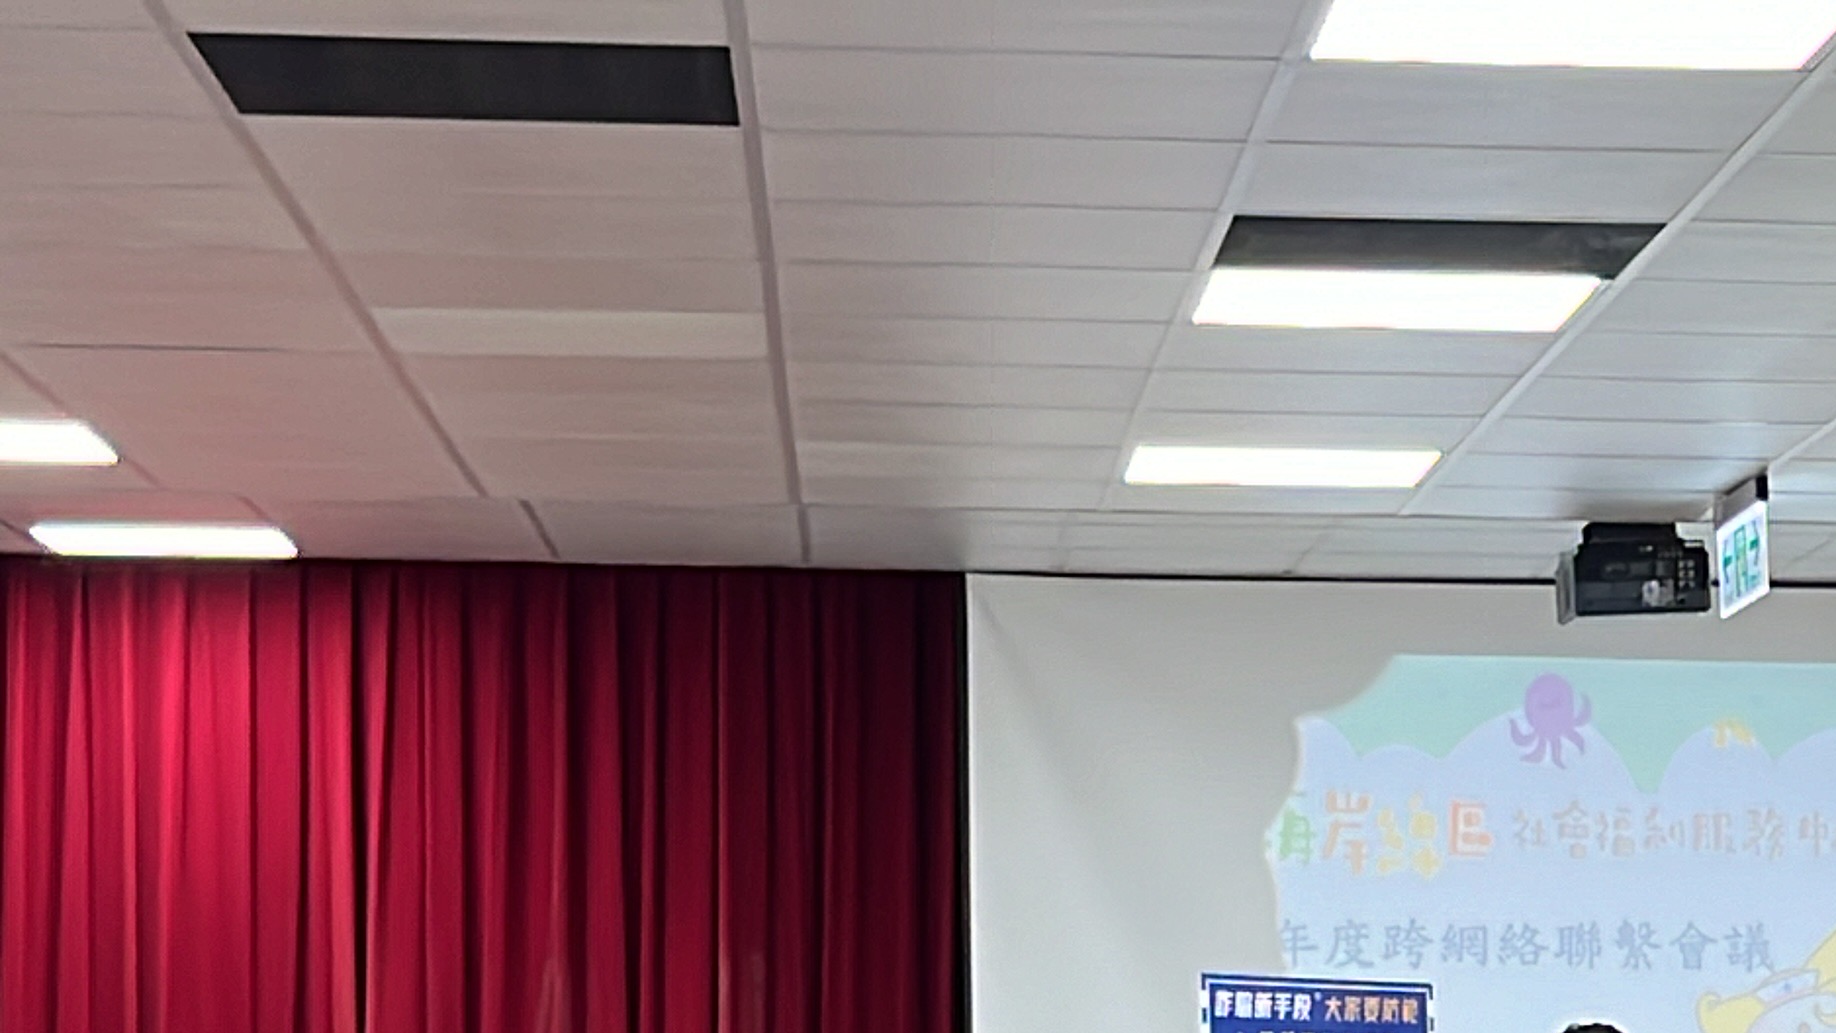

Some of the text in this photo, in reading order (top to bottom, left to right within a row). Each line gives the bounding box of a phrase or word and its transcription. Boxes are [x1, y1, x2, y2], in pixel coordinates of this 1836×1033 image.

[1282, 918, 1777, 974] 年度跨網絡聯繫會議
